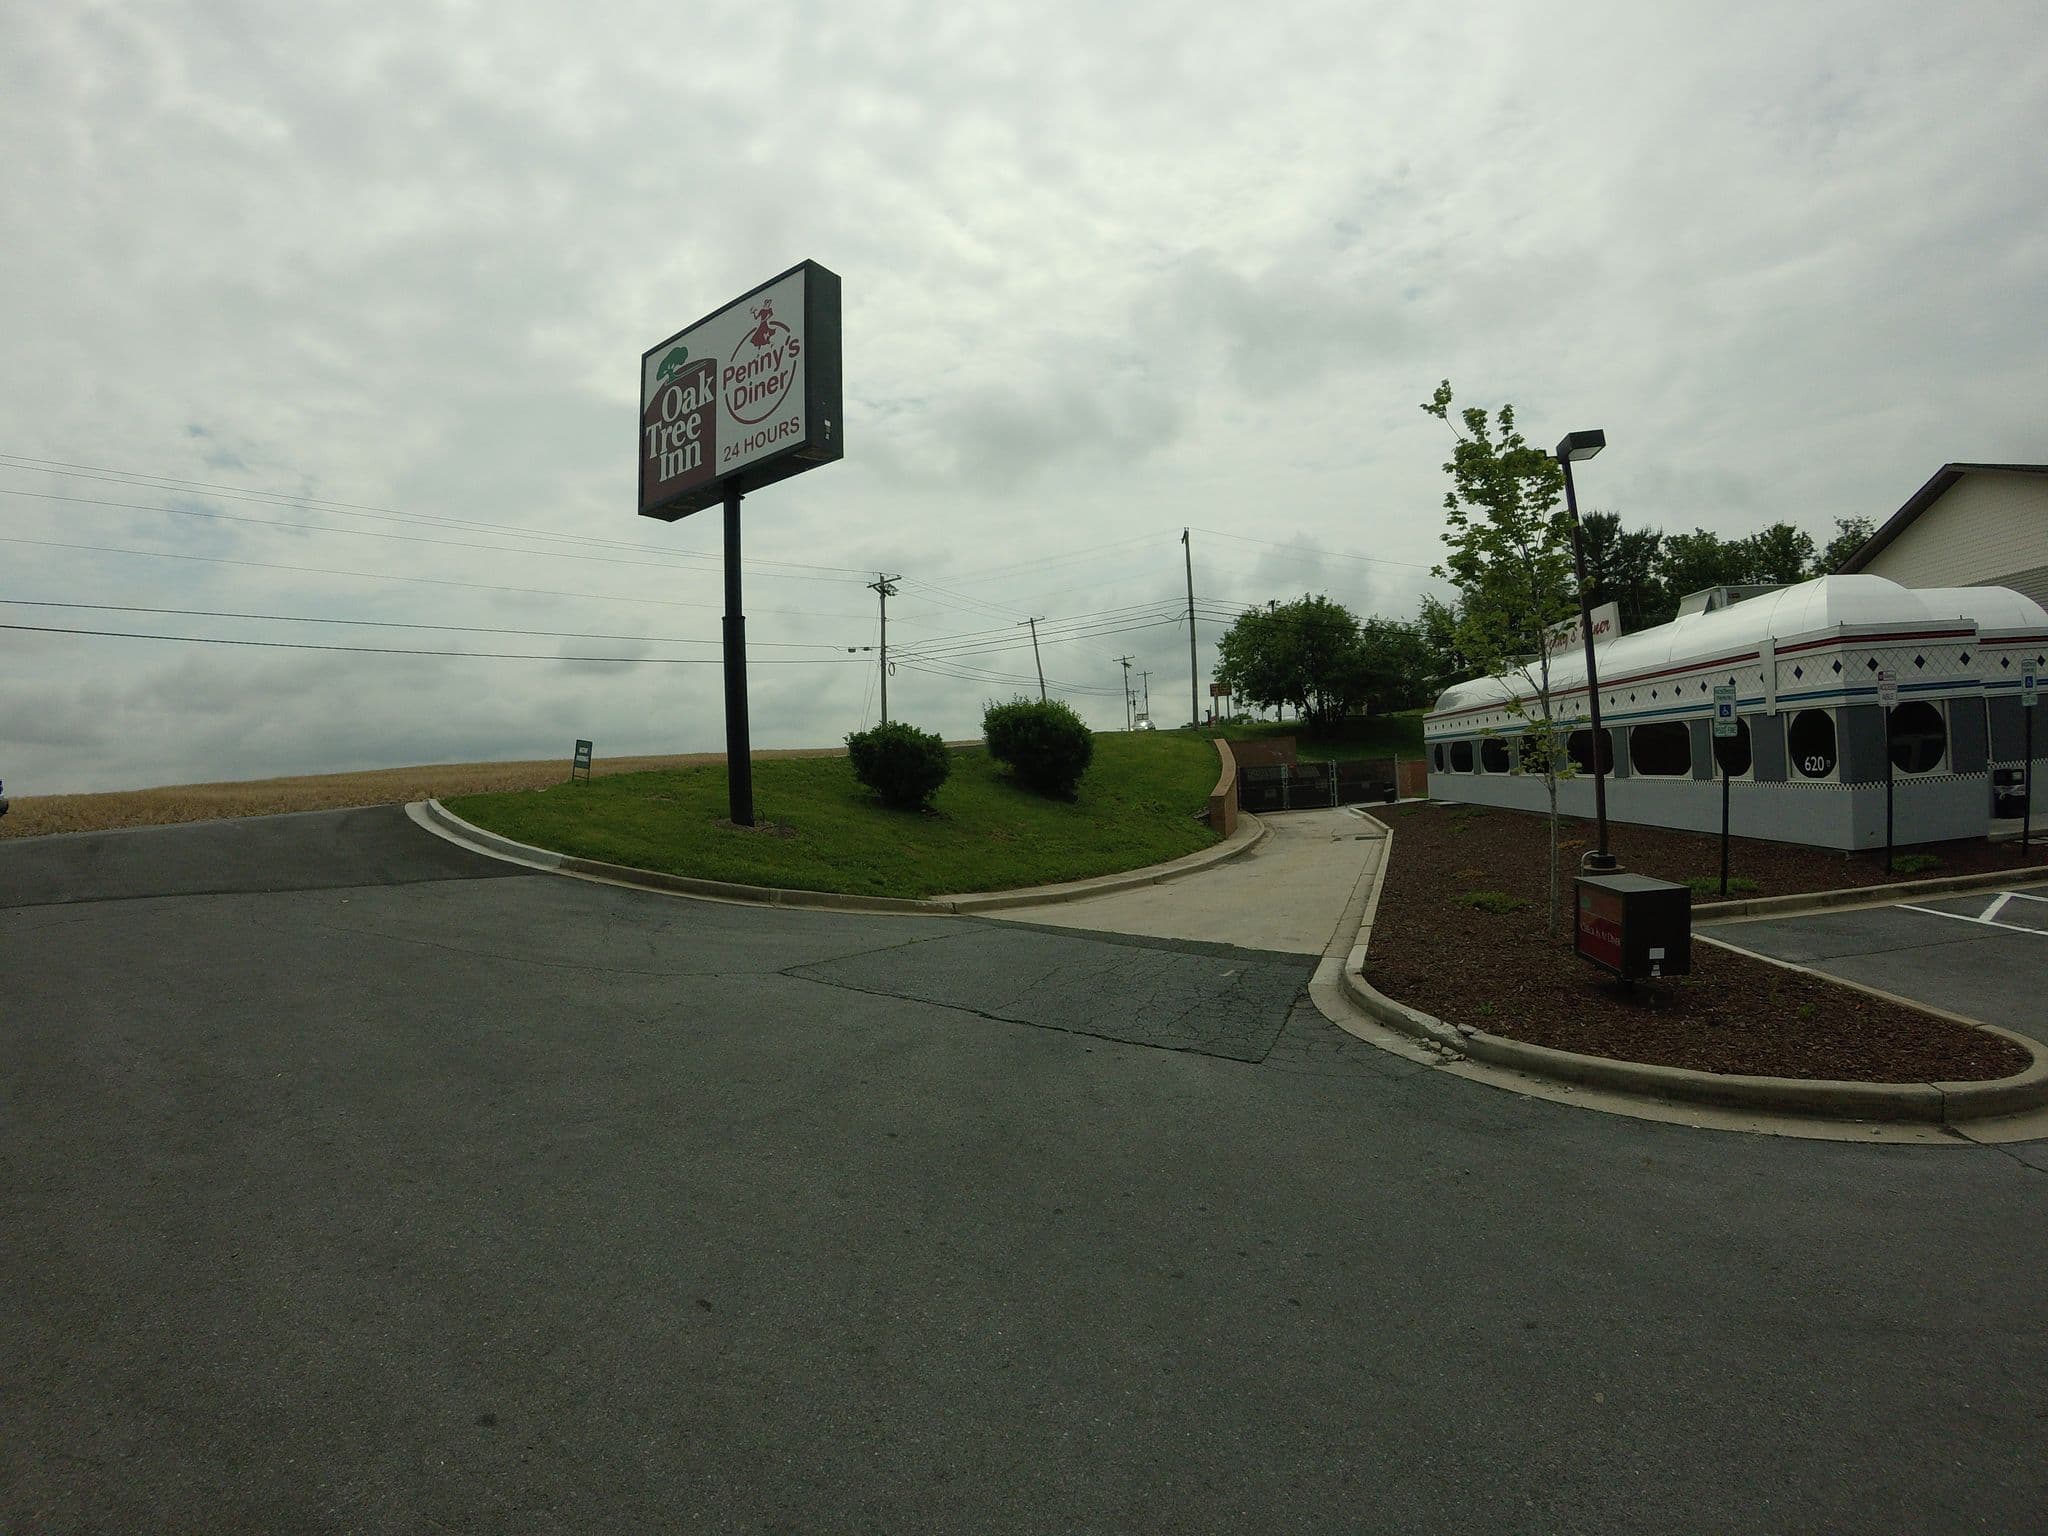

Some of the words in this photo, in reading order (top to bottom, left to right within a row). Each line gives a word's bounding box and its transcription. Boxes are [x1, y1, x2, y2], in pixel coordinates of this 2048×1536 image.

[723, 335, 800, 390] Penny's
[663, 370, 714, 422] Oak
[733, 370, 788, 411] Diner
[646, 413, 701, 460] Tree
[724, 443, 740, 462] 24
[744, 416, 800, 453] HOURS
[660, 440, 702, 482] Inn
[1580, 618, 1610, 641] ner
[1805, 756, 1824, 771] 620
